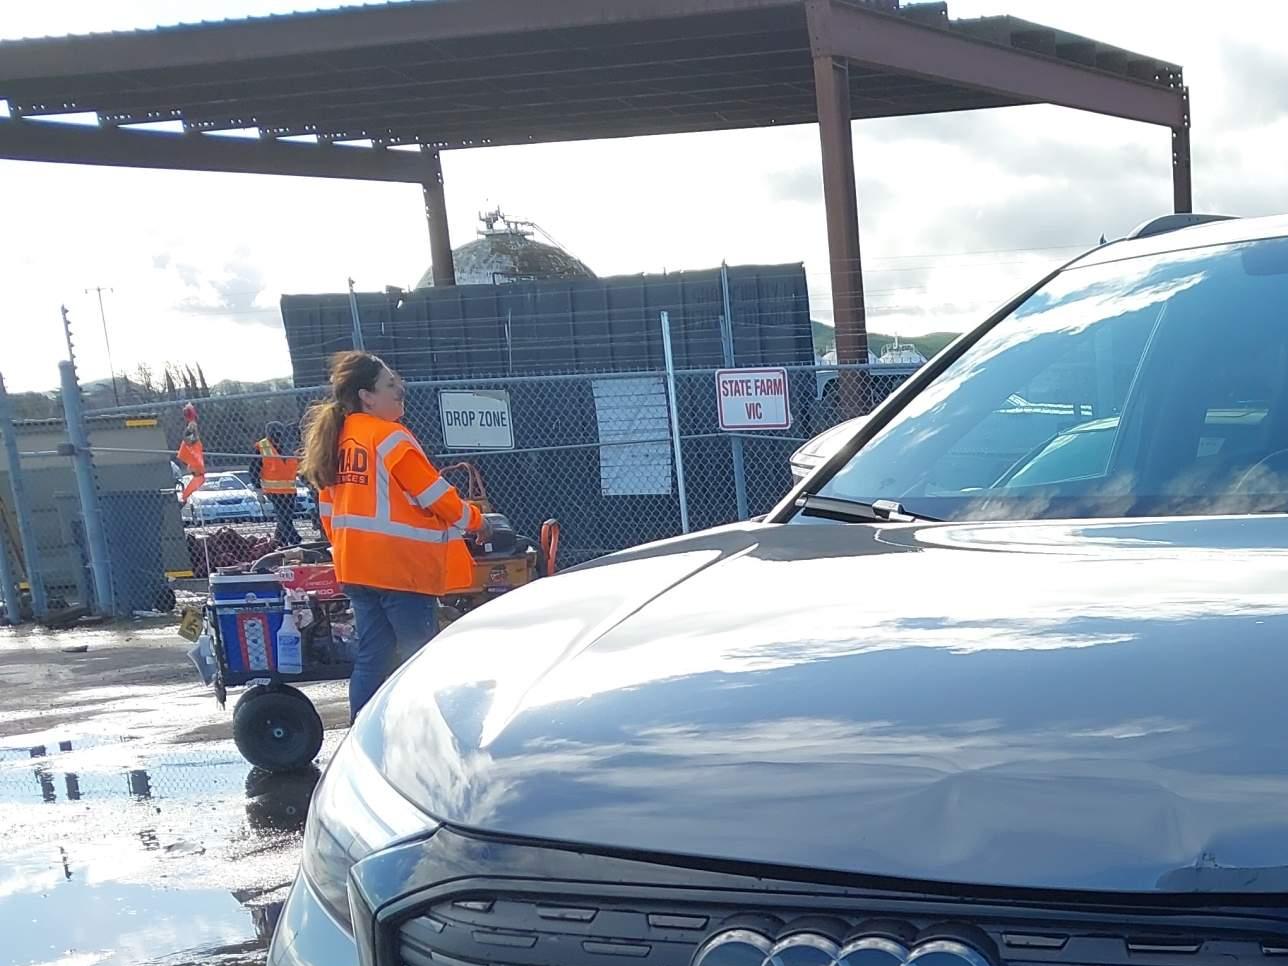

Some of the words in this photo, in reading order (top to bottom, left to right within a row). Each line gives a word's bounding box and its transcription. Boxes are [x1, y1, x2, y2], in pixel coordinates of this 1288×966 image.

[722, 379, 753, 397] STATE
[754, 378, 783, 396] FARM
[446, 411, 476, 427] DROP
[479, 411, 508, 427] ZONE
[745, 402, 763, 420] VIC
